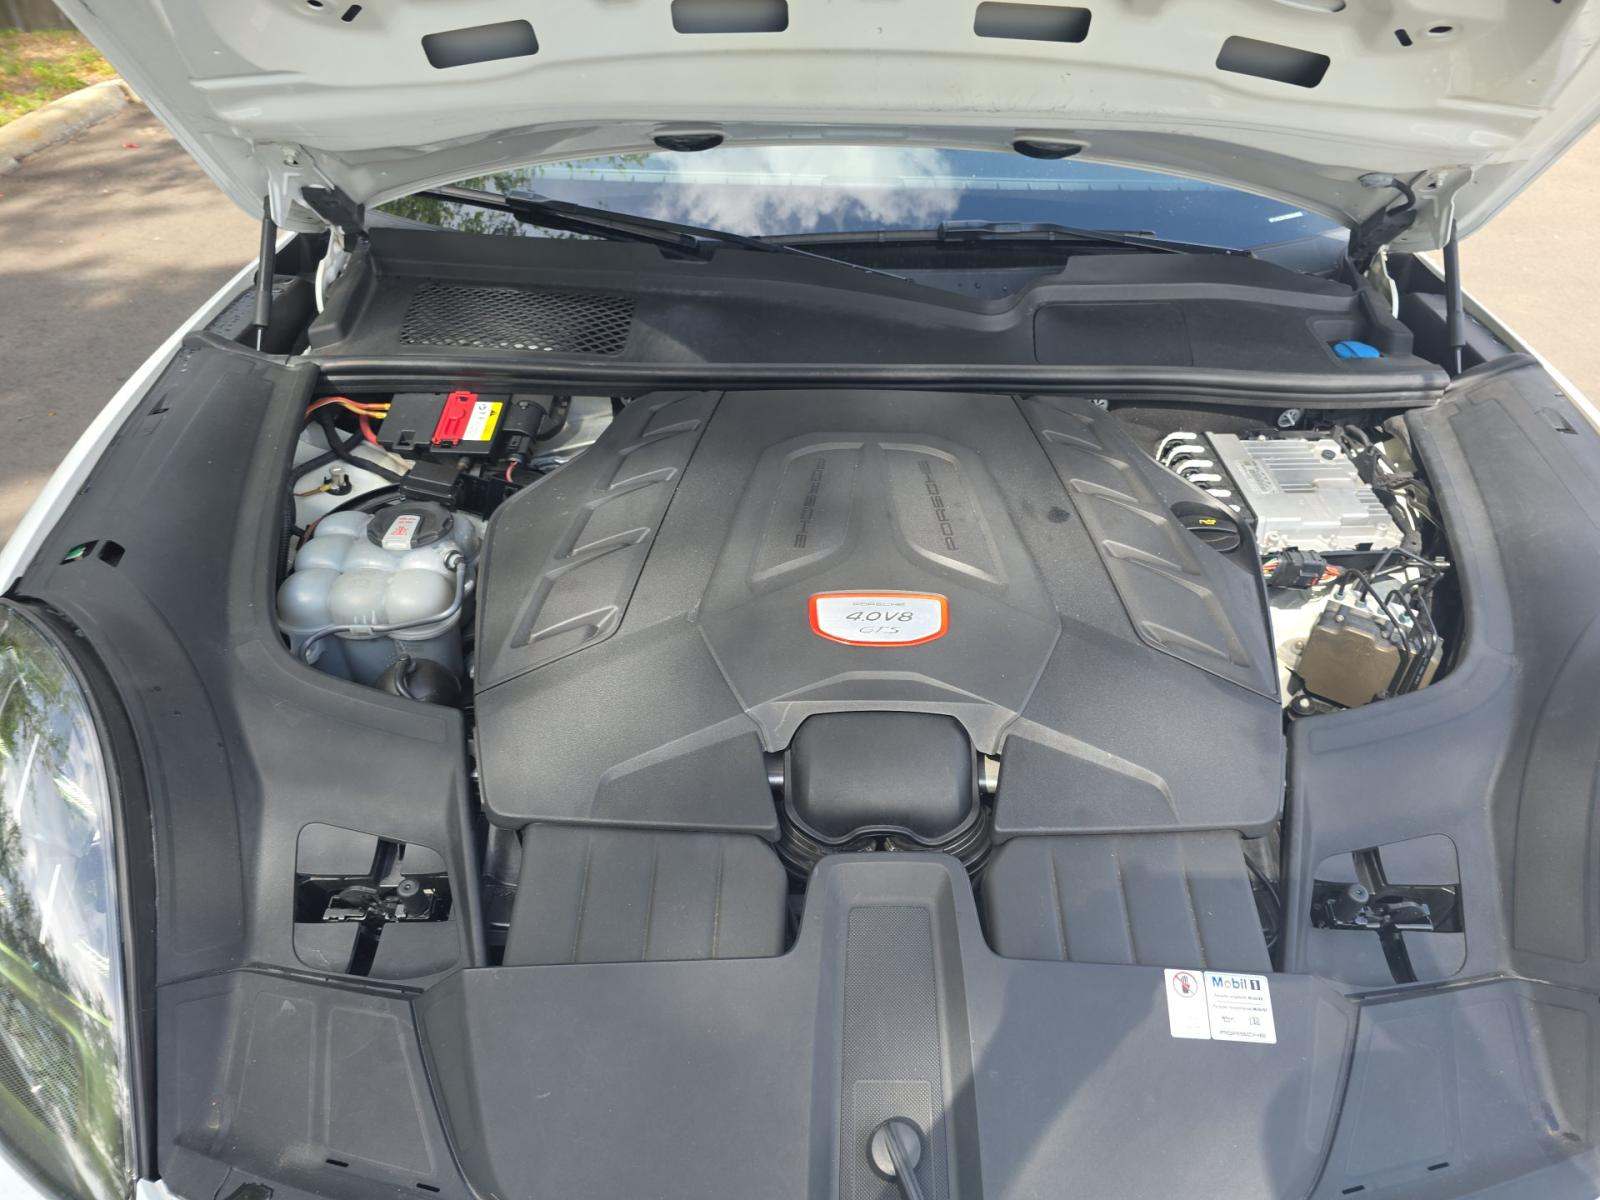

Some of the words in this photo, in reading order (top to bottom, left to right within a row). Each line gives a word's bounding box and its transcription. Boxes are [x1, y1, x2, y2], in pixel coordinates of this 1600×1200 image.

[918, 460, 957, 550] PORSCHE
[1212, 976, 1247, 990] Mobil
[1250, 980, 1260, 990] 1
